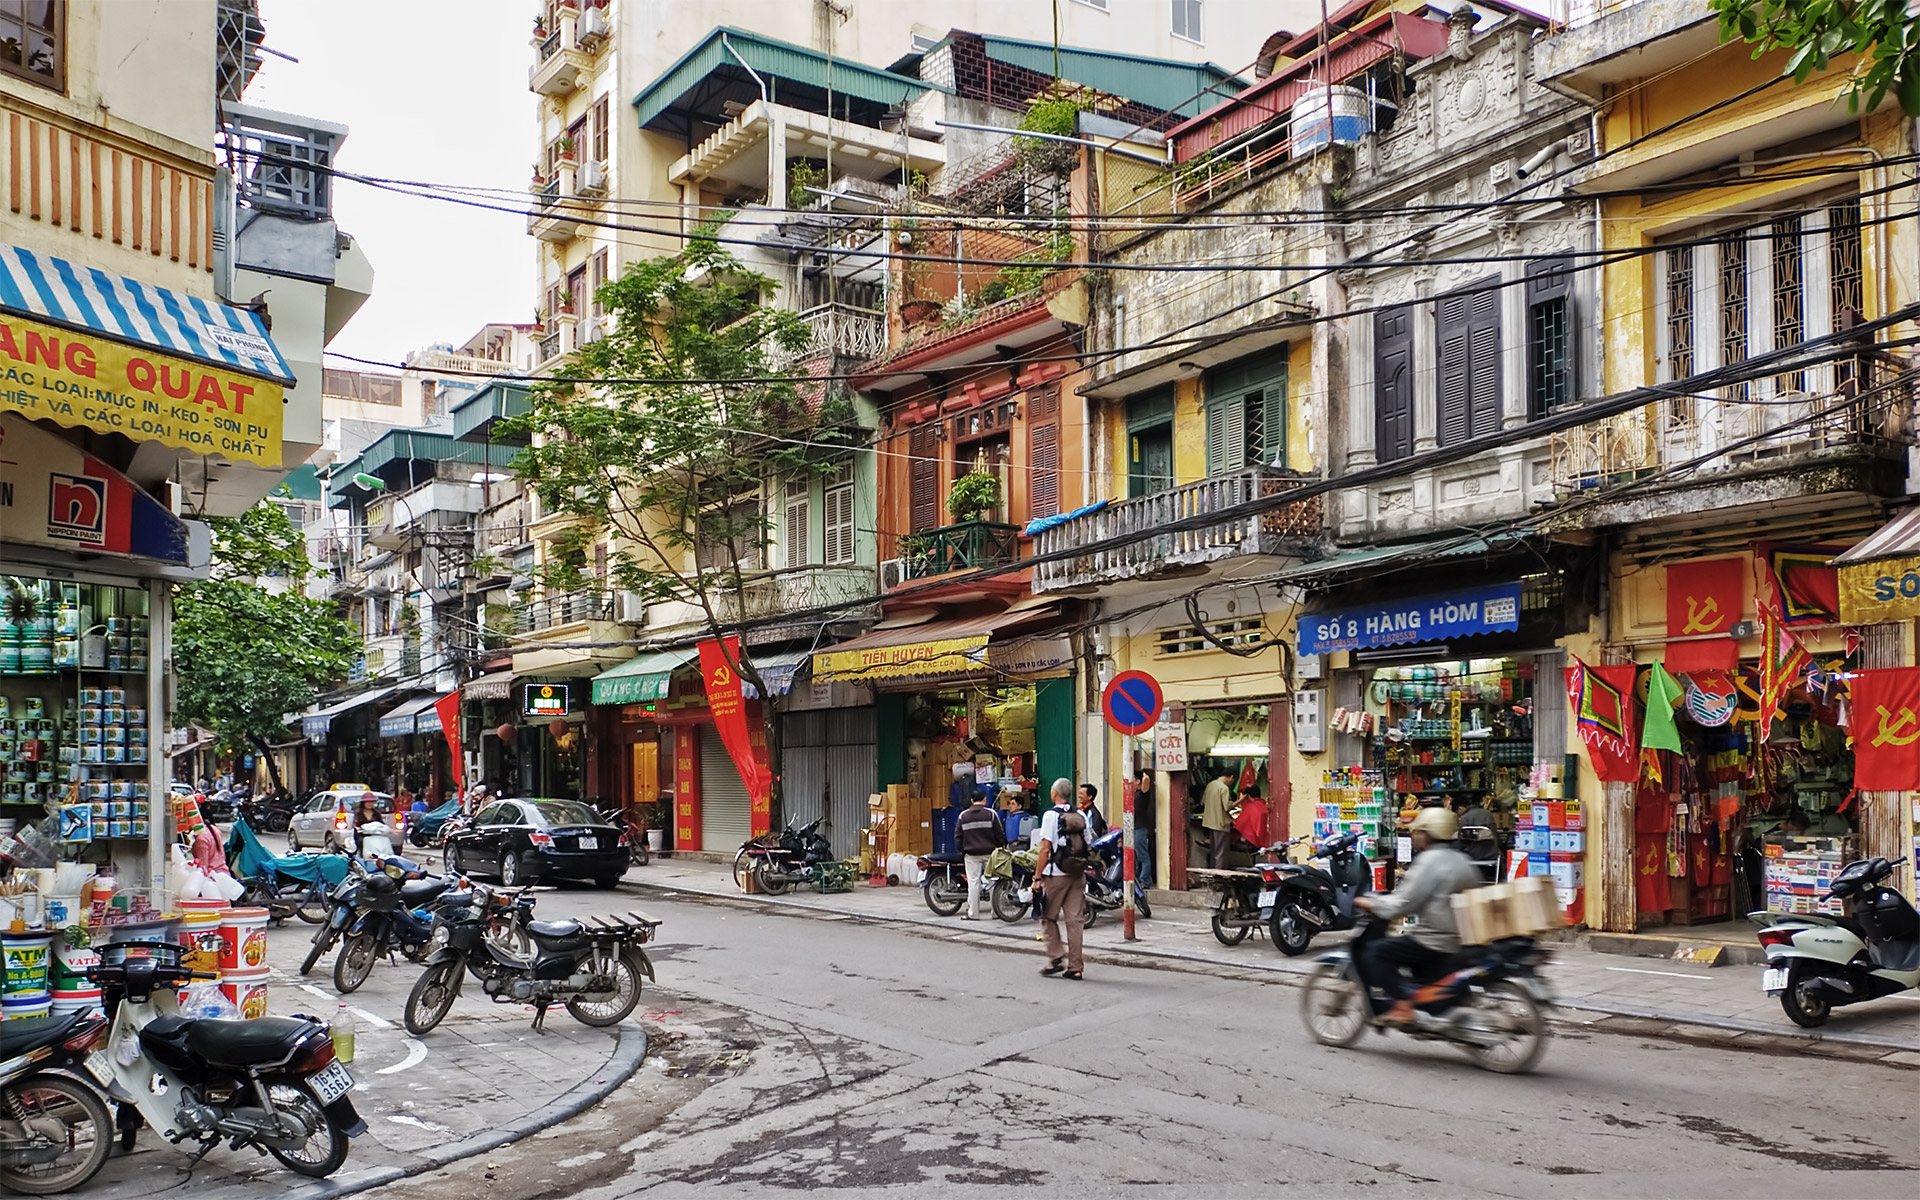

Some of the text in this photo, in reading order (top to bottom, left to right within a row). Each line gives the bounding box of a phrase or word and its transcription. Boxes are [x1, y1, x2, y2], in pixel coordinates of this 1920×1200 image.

[126, 358, 254, 415] QUẠT
[143, 400, 159, 414] IN
[171, 406, 199, 423] KEO
[248, 425, 268, 439] PU
[48, 399, 74, 416] VÀ
[84, 406, 122, 426] CÁC
[131, 418, 171, 438] LOẠI
[179, 429, 214, 446] HOÁ
[222, 438, 265, 456] CHẤT
[47, 526, 102, 540] NIPPON PAINT
[1317, 614, 1343, 641] SỐ
[1347, 620, 1358, 637] 8
[1366, 610, 1421, 635] HÀNG
[1430, 601, 1478, 626] HÒM
[1738, 624, 1745, 636] 6
[821, 656, 831, 667] 12
[1159, 751, 1183, 765] TÓC
[1566, 803, 1580, 811] ATM
[8, 949, 46, 962] ATM
